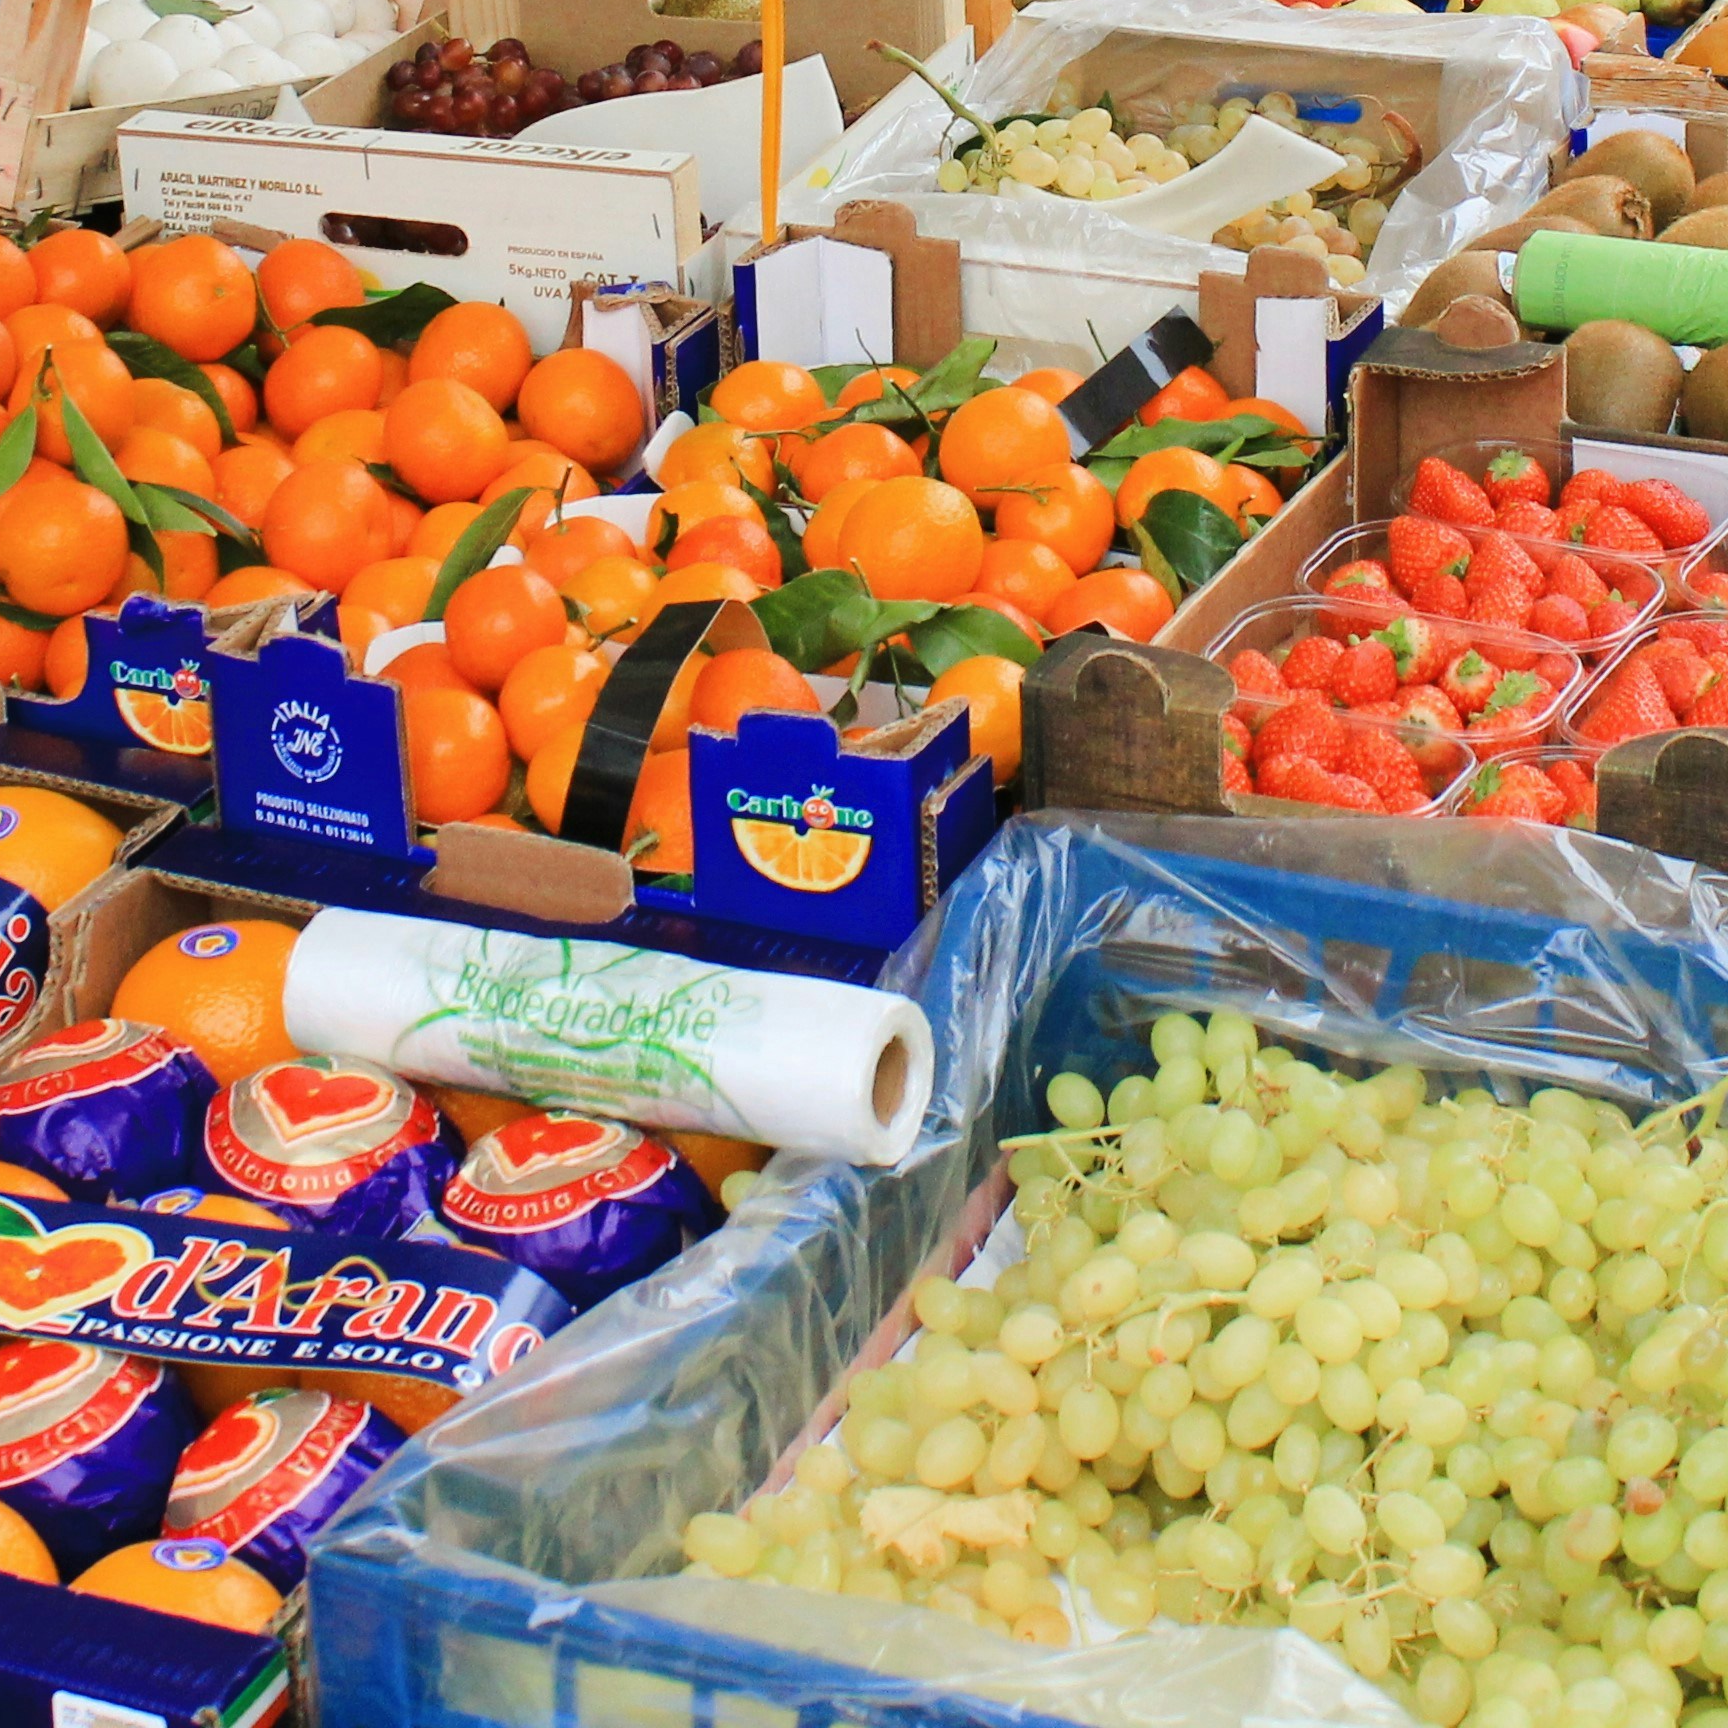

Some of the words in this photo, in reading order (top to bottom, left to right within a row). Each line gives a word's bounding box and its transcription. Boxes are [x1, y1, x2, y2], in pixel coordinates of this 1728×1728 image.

[159, 171, 196, 186] ARACIL
[197, 175, 248, 190] MARTINEZ
[249, 178, 256, 190] Y
[258, 180, 303, 194] MORILLO
[304, 184, 324, 197] S.L.
[507, 244, 557, 259] PRODUCIDO
[557, 249, 571, 260] EN
[532, 284, 565, 301] UVA
[276, 700, 331, 731] ITALIA
[255, 791, 304, 815] PRODOTTO
[306, 800, 370, 828] SELEZIONATO
[77, 1317, 275, 1358] PASSIONE
[294, 1340, 319, 1360] E
[326, 1342, 446, 1374] SOLO
